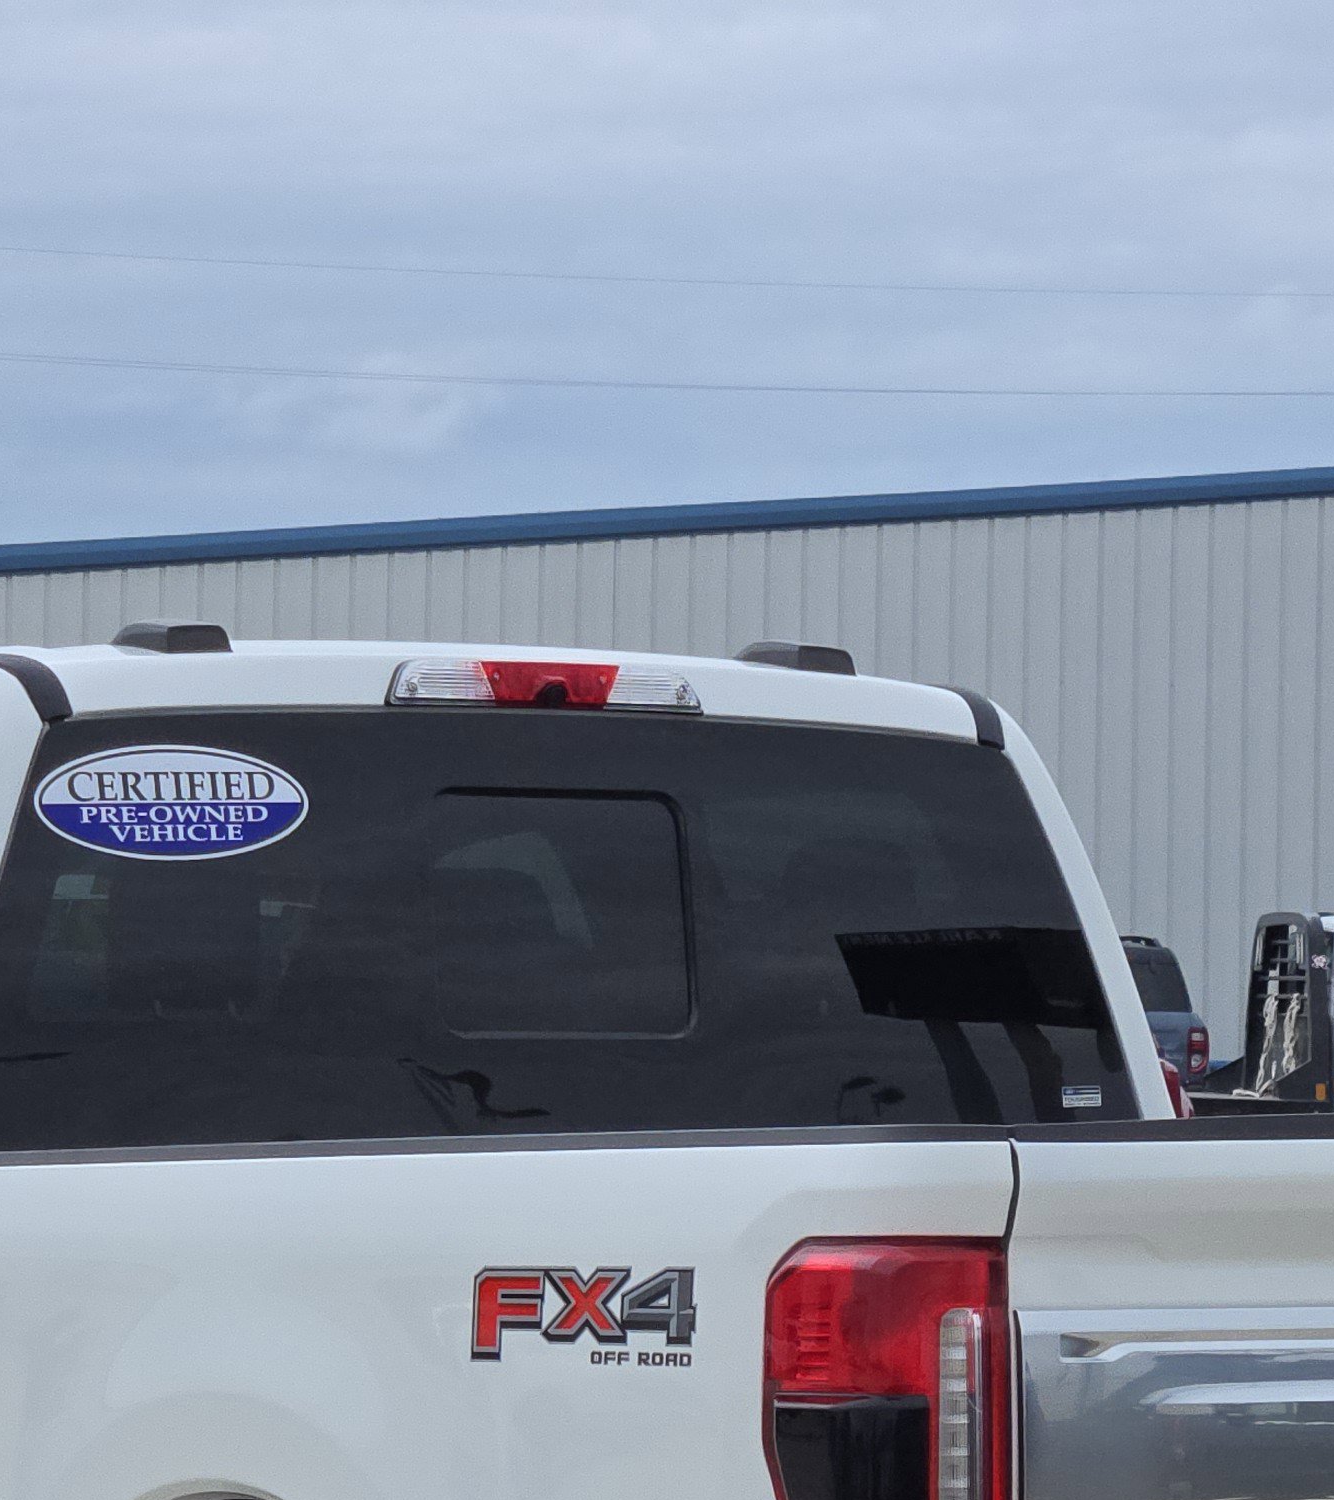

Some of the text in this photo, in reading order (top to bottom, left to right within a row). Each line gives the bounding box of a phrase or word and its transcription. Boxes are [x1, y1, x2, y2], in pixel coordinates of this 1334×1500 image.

[66, 770, 275, 803] CERTIFIED
[79, 804, 268, 824] PRE-OWNED
[108, 823, 244, 843] VEHICLE
[470, 1265, 697, 1362] FX4
[590, 1350, 692, 1367] OFF ROAD
